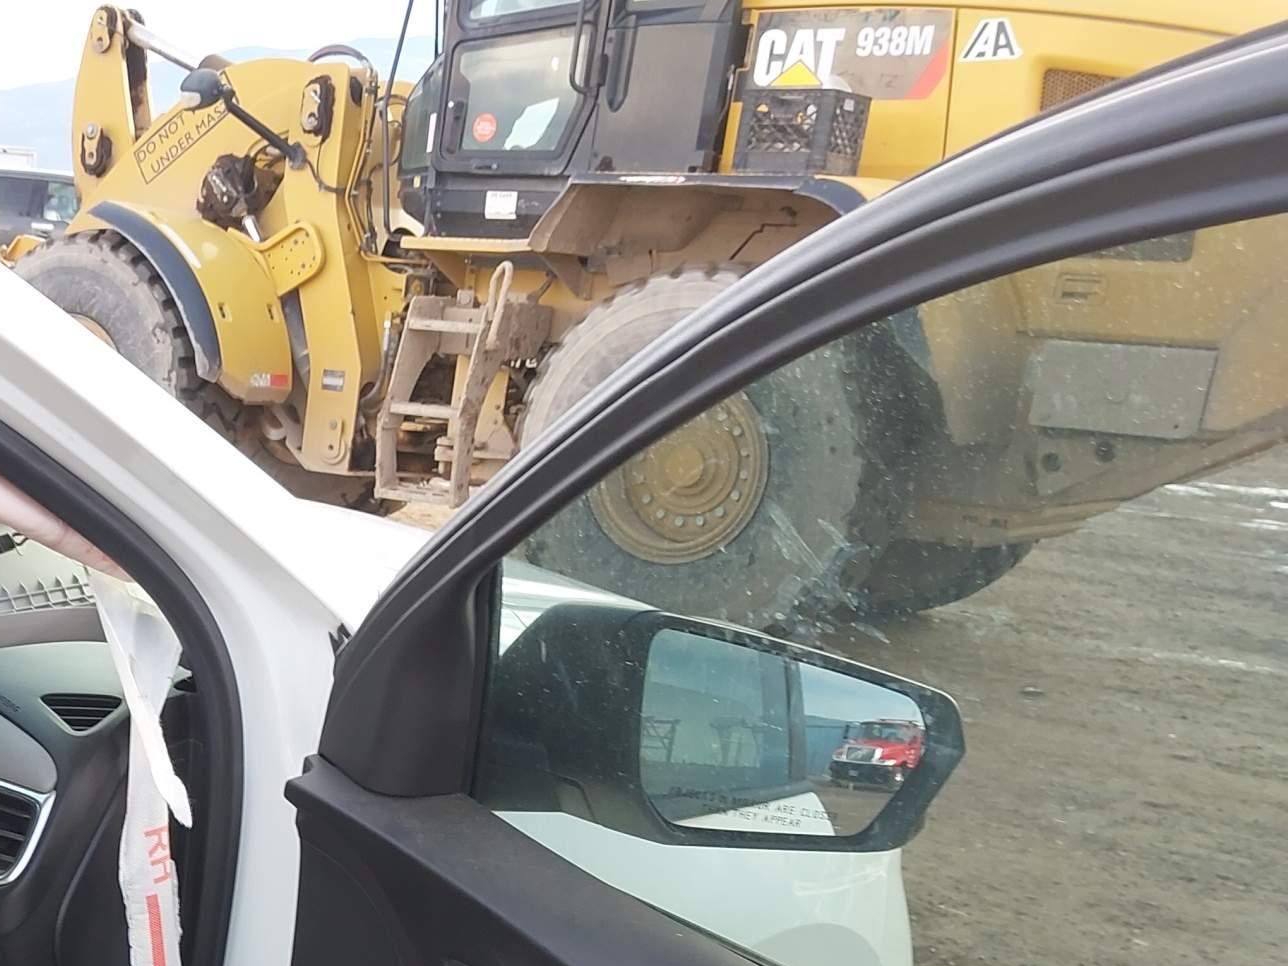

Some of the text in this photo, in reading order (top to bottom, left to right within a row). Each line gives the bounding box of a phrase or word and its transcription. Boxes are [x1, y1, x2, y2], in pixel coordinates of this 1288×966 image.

[752, 28, 845, 90] CAT
[855, 25, 935, 57] 938M
[136, 113, 186, 163] DO NOT
[150, 132, 195, 174] UNDER
[763, 814, 802, 828] APPEAR
[776, 804, 795, 815] ARE
